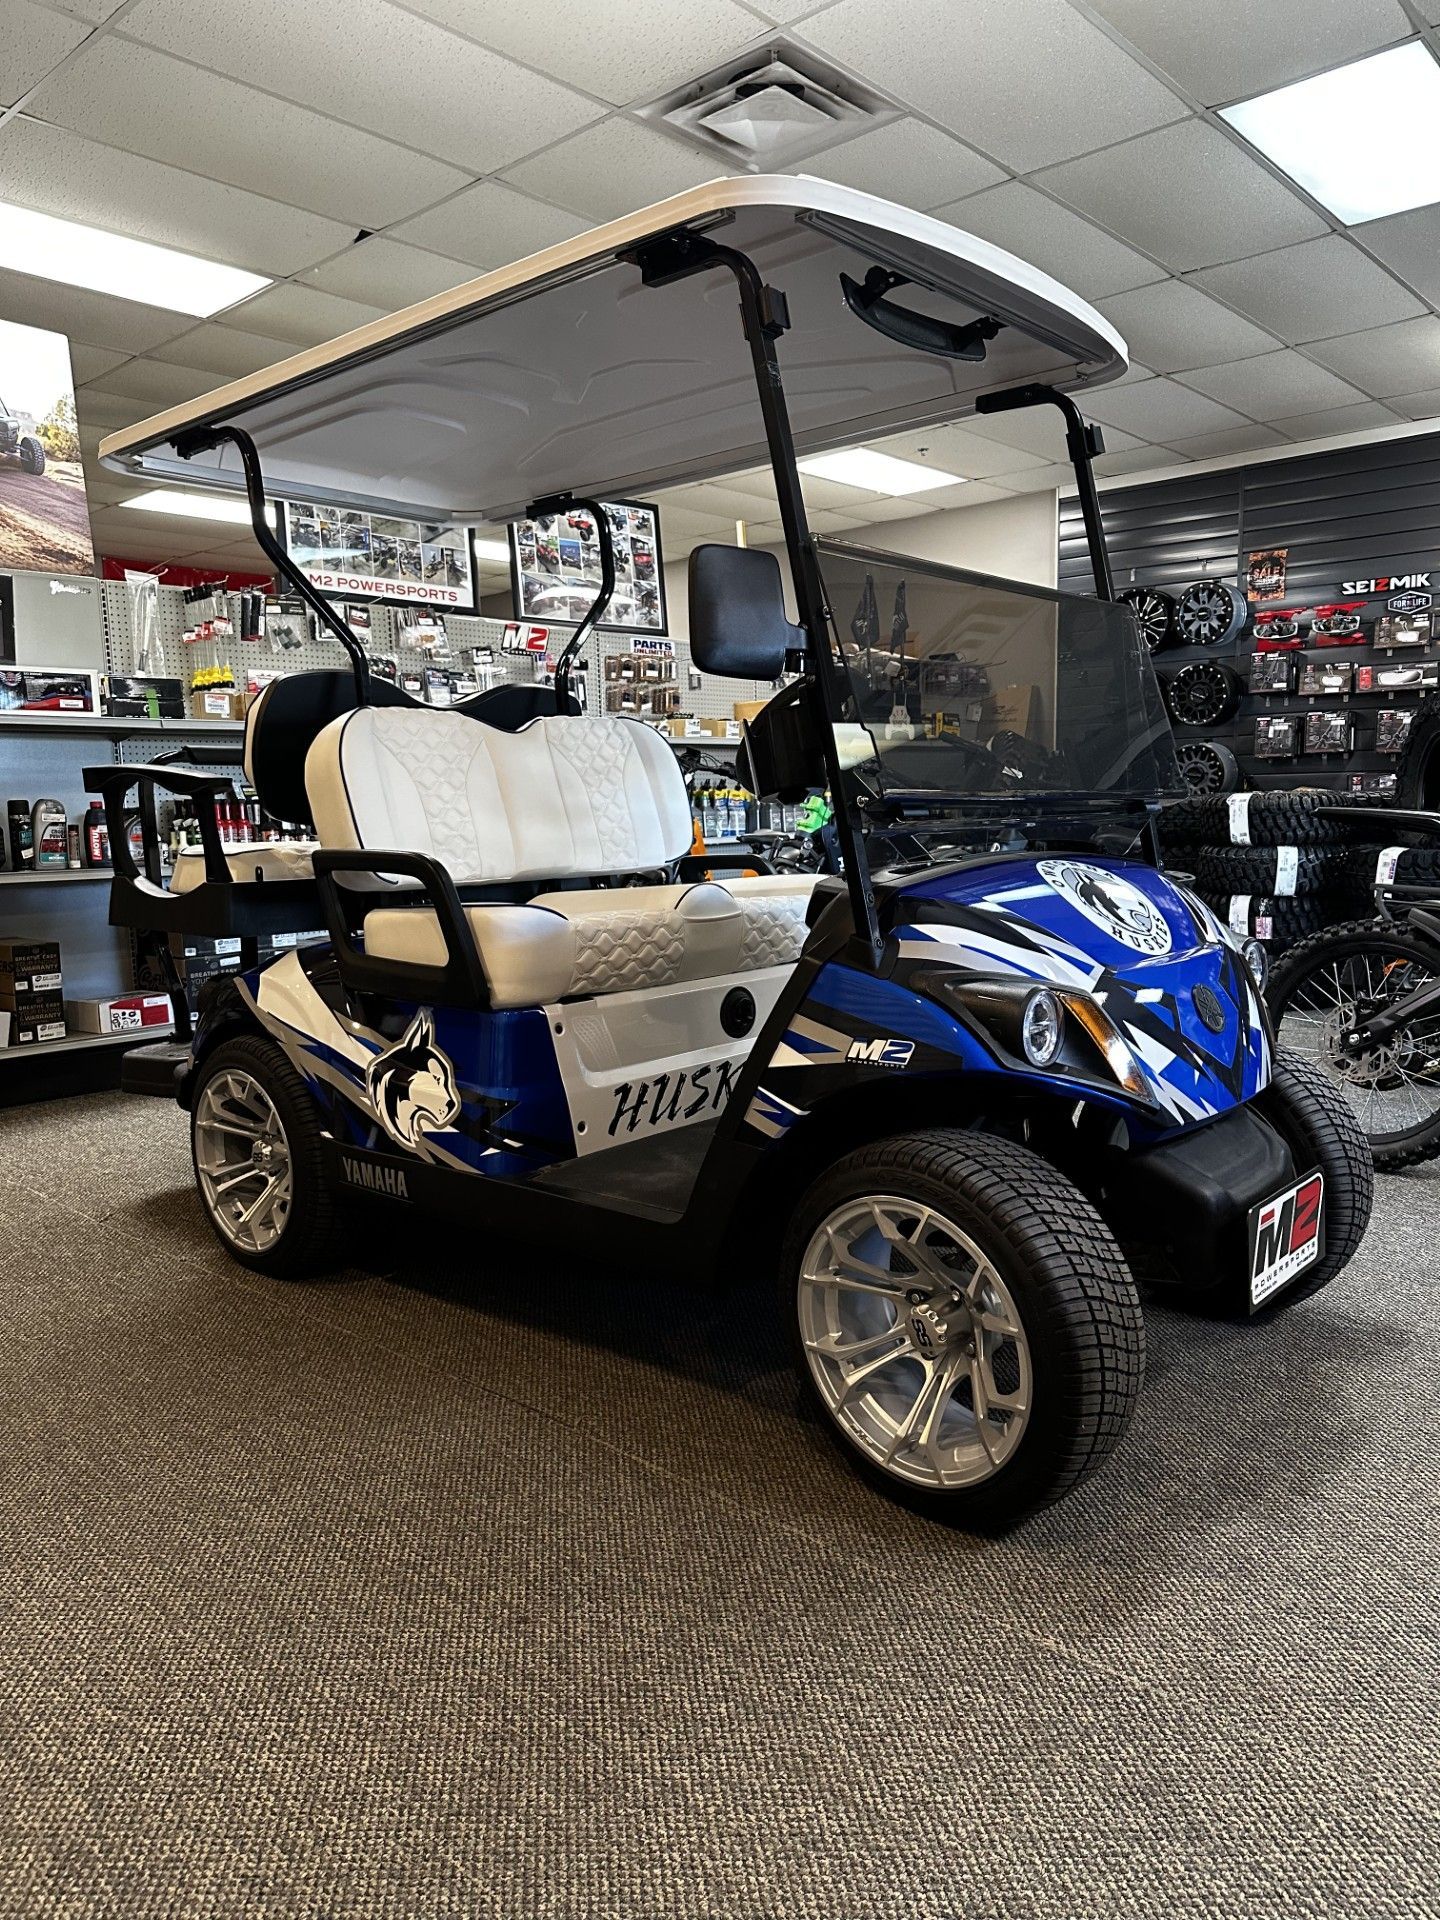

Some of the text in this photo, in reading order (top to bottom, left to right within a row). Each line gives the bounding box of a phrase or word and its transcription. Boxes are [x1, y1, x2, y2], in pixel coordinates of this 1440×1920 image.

[1253, 566, 1280, 577] SALE
[1341, 573, 1431, 595] SEIZMIK
[309, 574, 458, 602] M2 POWERSPORTS
[1393, 600, 1407, 609] FOR
[1412, 597, 1427, 607] LIFE
[503, 624, 548, 651] M2
[633, 639, 673, 650] PARTS
[633, 648, 673, 656] UNLIMITED
[92, 826, 101, 856] MOTUL
[1111, 914, 1168, 952] HUSKIES
[848, 1039, 915, 1065] M2
[342, 1156, 409, 1198] YAMAHA
[1254, 1180, 1321, 1279] M2
[1254, 1240, 1316, 1290] POWERSPORTS
